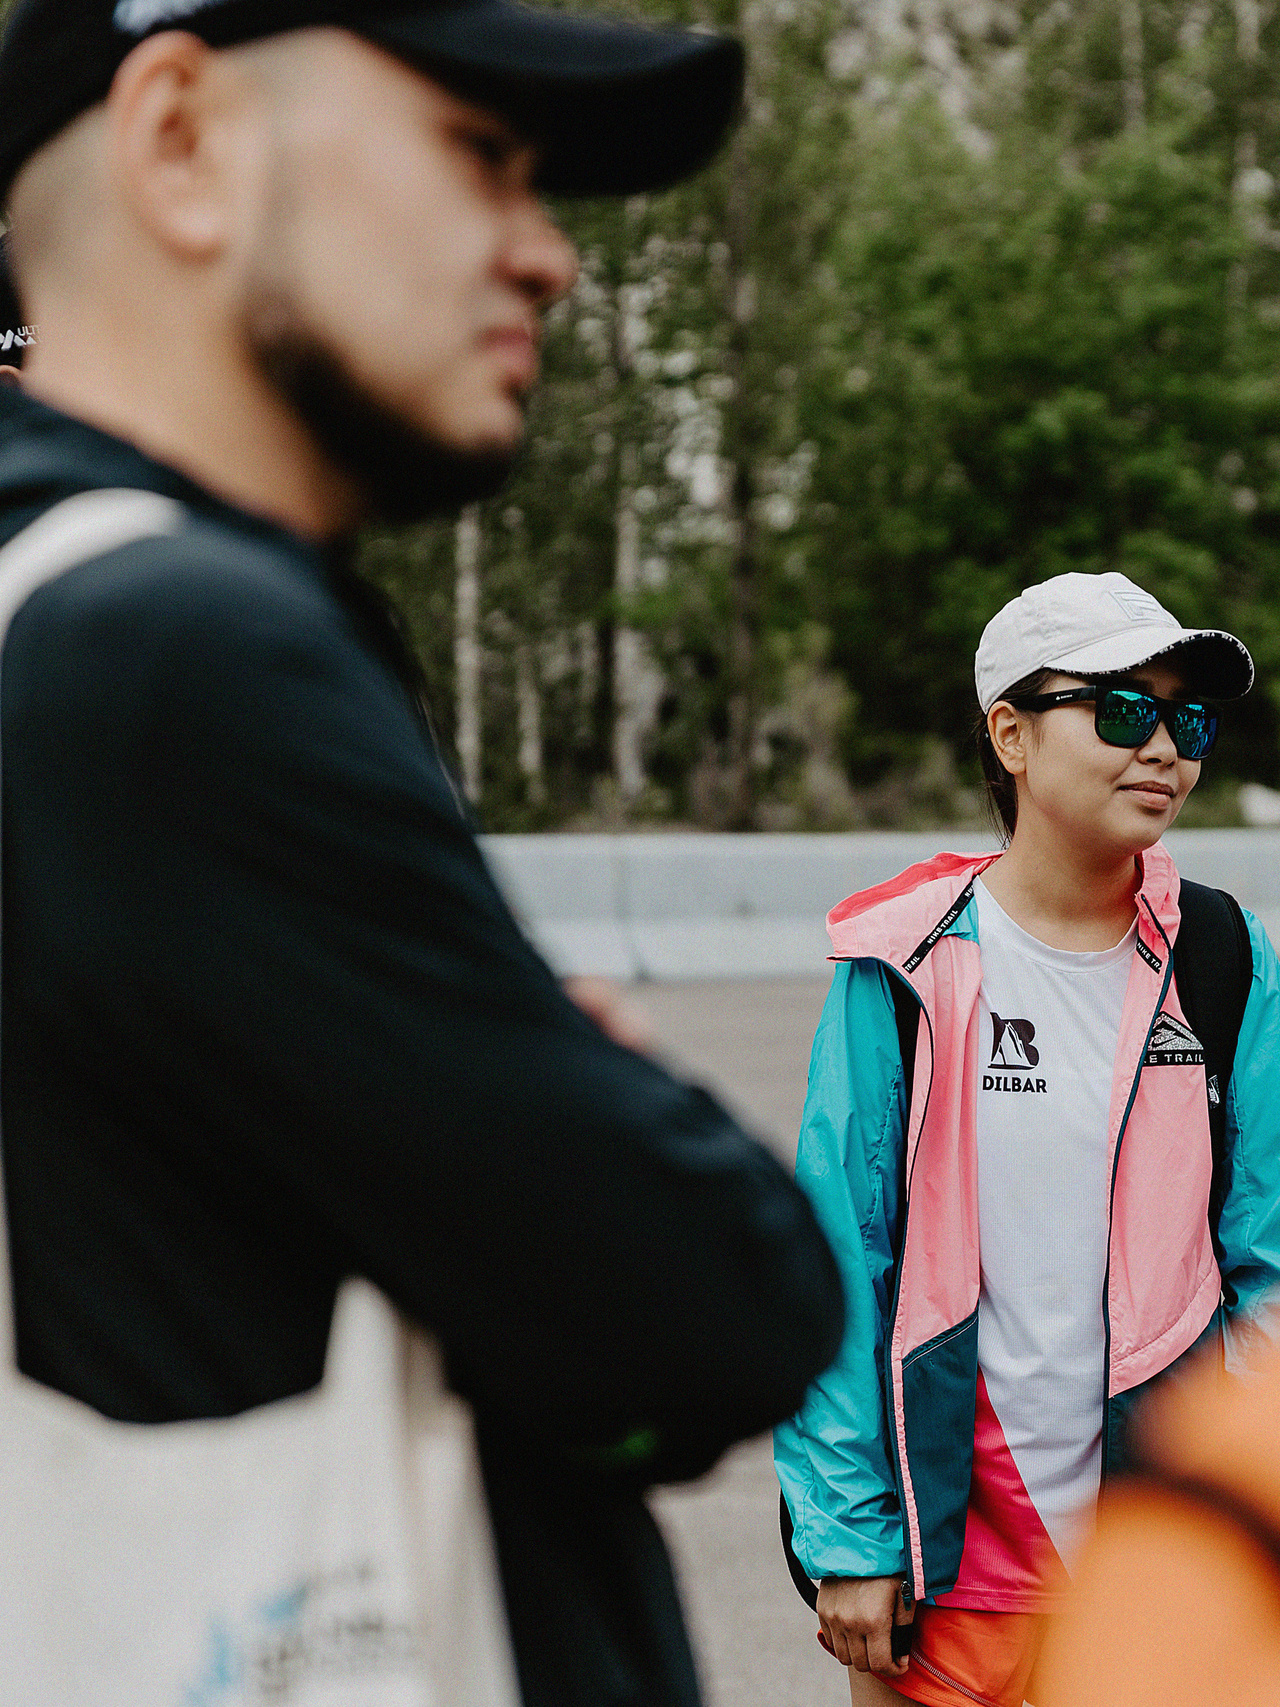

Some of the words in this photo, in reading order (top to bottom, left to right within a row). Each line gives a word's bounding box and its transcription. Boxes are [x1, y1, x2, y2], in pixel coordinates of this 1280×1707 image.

[927, 927, 943, 944] NIKE
[940, 910, 958, 928] TRAIL
[904, 956, 920, 971] TRAIL
[1137, 942, 1151, 959] NIKE
[1150, 958, 1161, 970] TR
[1164, 1054, 1204, 1062] TRAIL
[982, 1075, 1047, 1093] DILBAR
